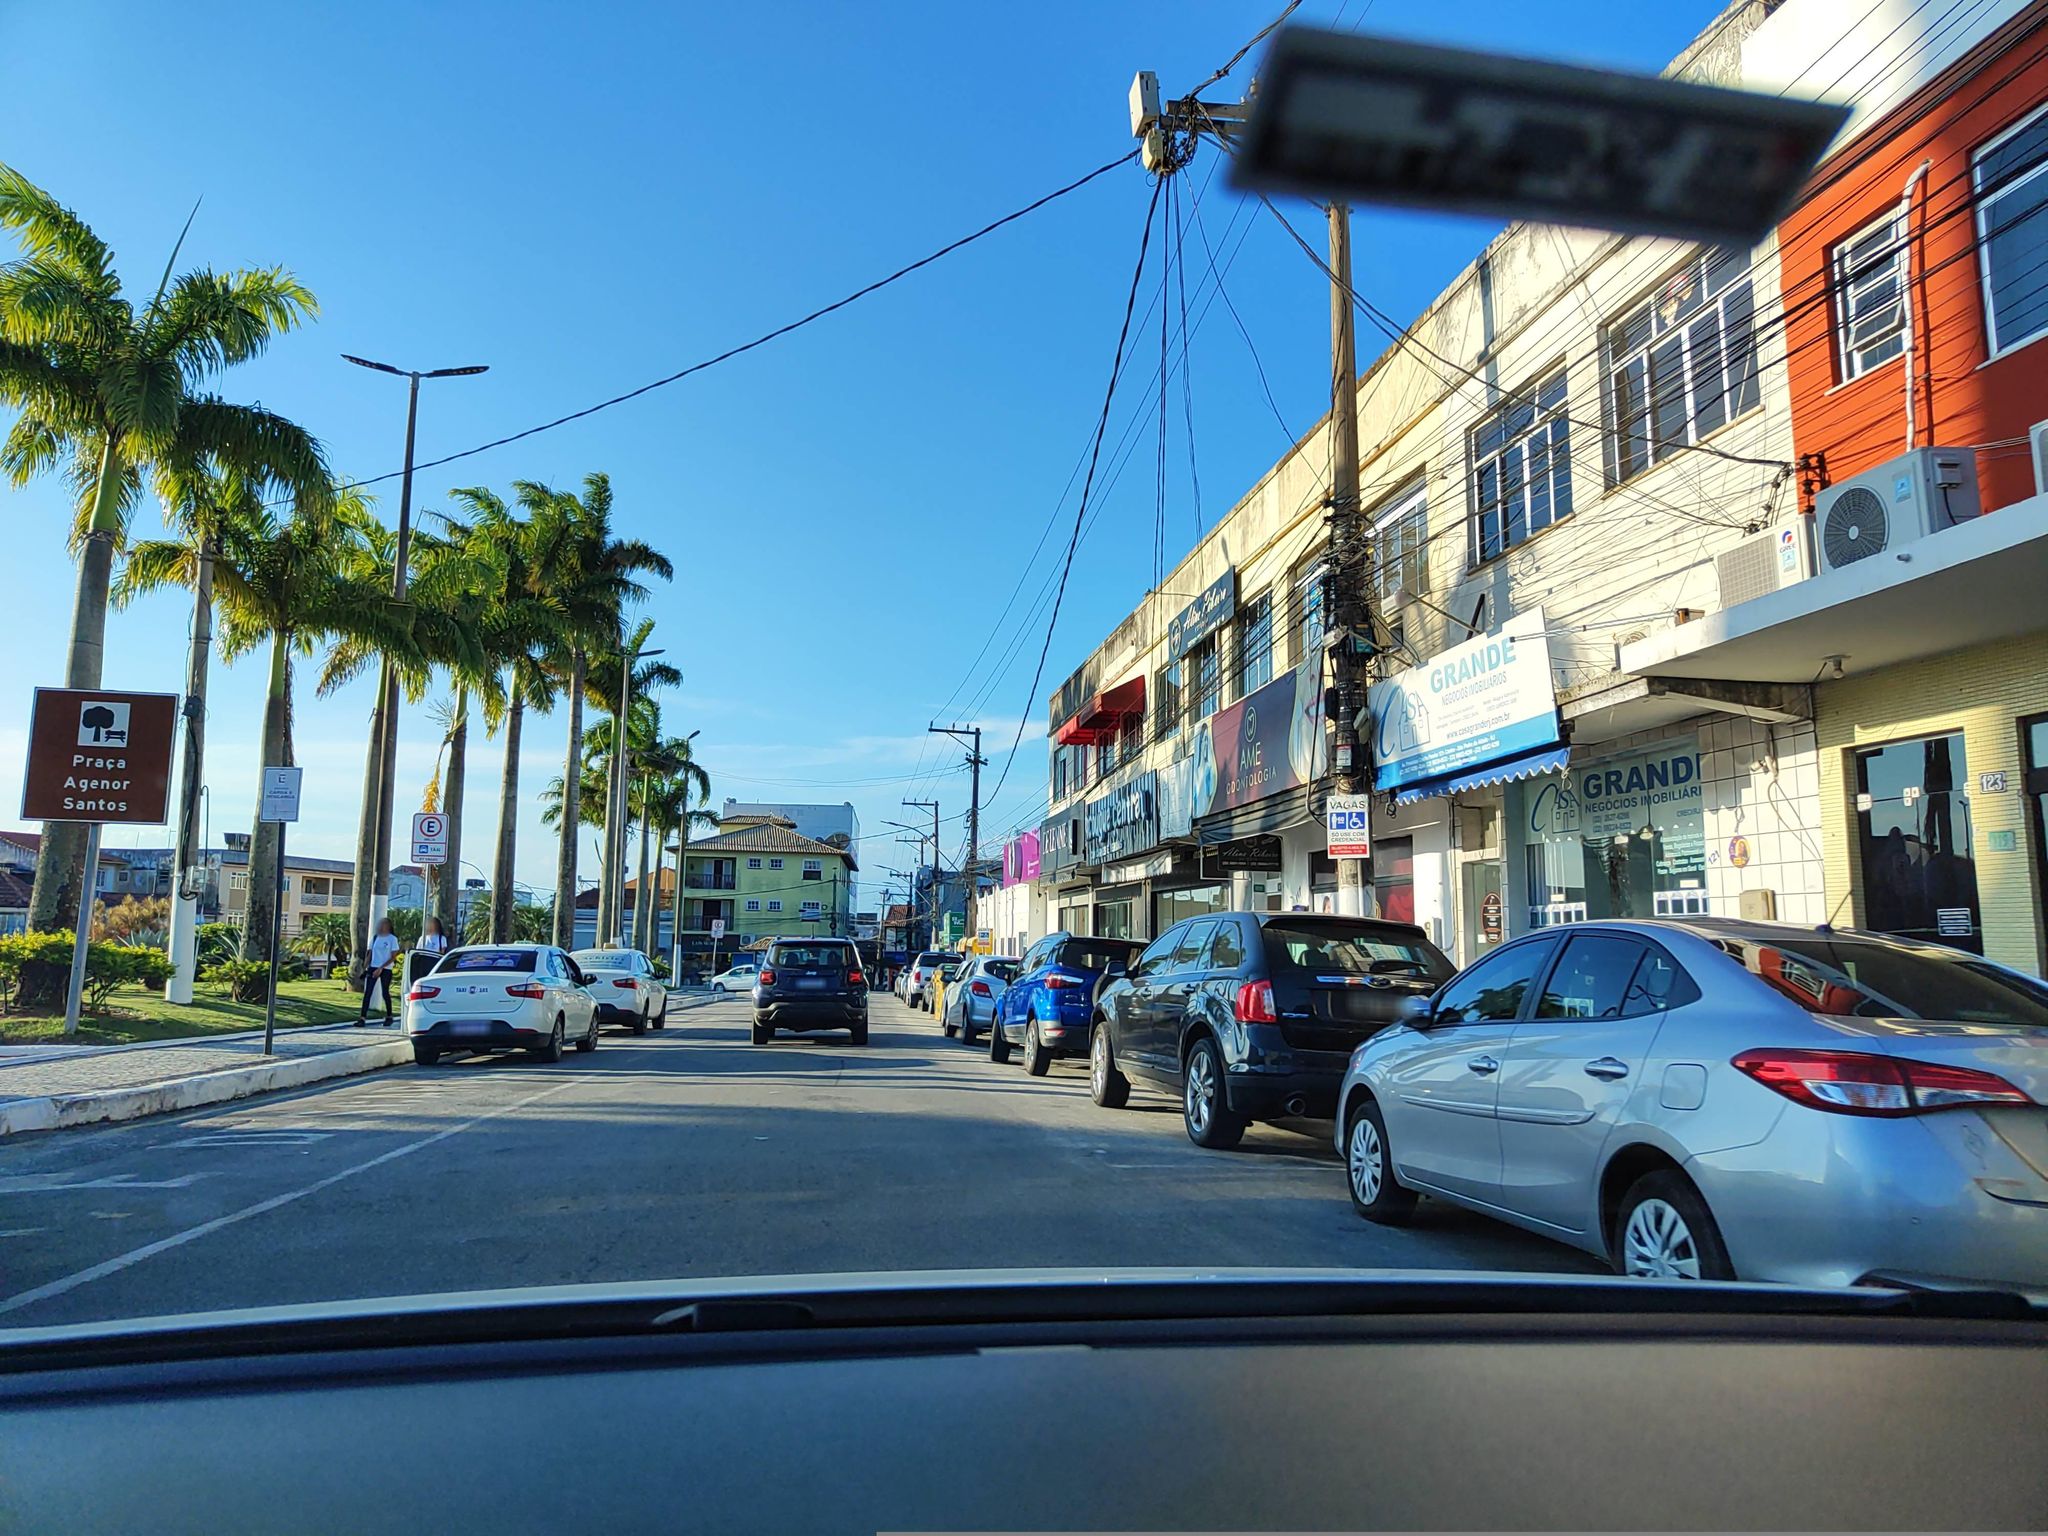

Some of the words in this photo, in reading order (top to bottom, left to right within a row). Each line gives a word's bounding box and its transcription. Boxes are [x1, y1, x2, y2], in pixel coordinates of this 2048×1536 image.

[1430, 636, 1517, 694] GRANDE
[72, 754, 126, 771] Praça
[1240, 742, 1261, 771] AME
[63, 776, 131, 793] Agenor
[1226, 765, 1277, 795] ODONTOLOGIA
[1981, 774, 2003, 792] 123
[62, 797, 128, 812] Santos
[1330, 801, 1366, 810] VAGAS
[1584, 796, 1638, 814] NEGÓCIOS
[427, 820, 435, 833] E
[1708, 850, 1721, 865] 121
